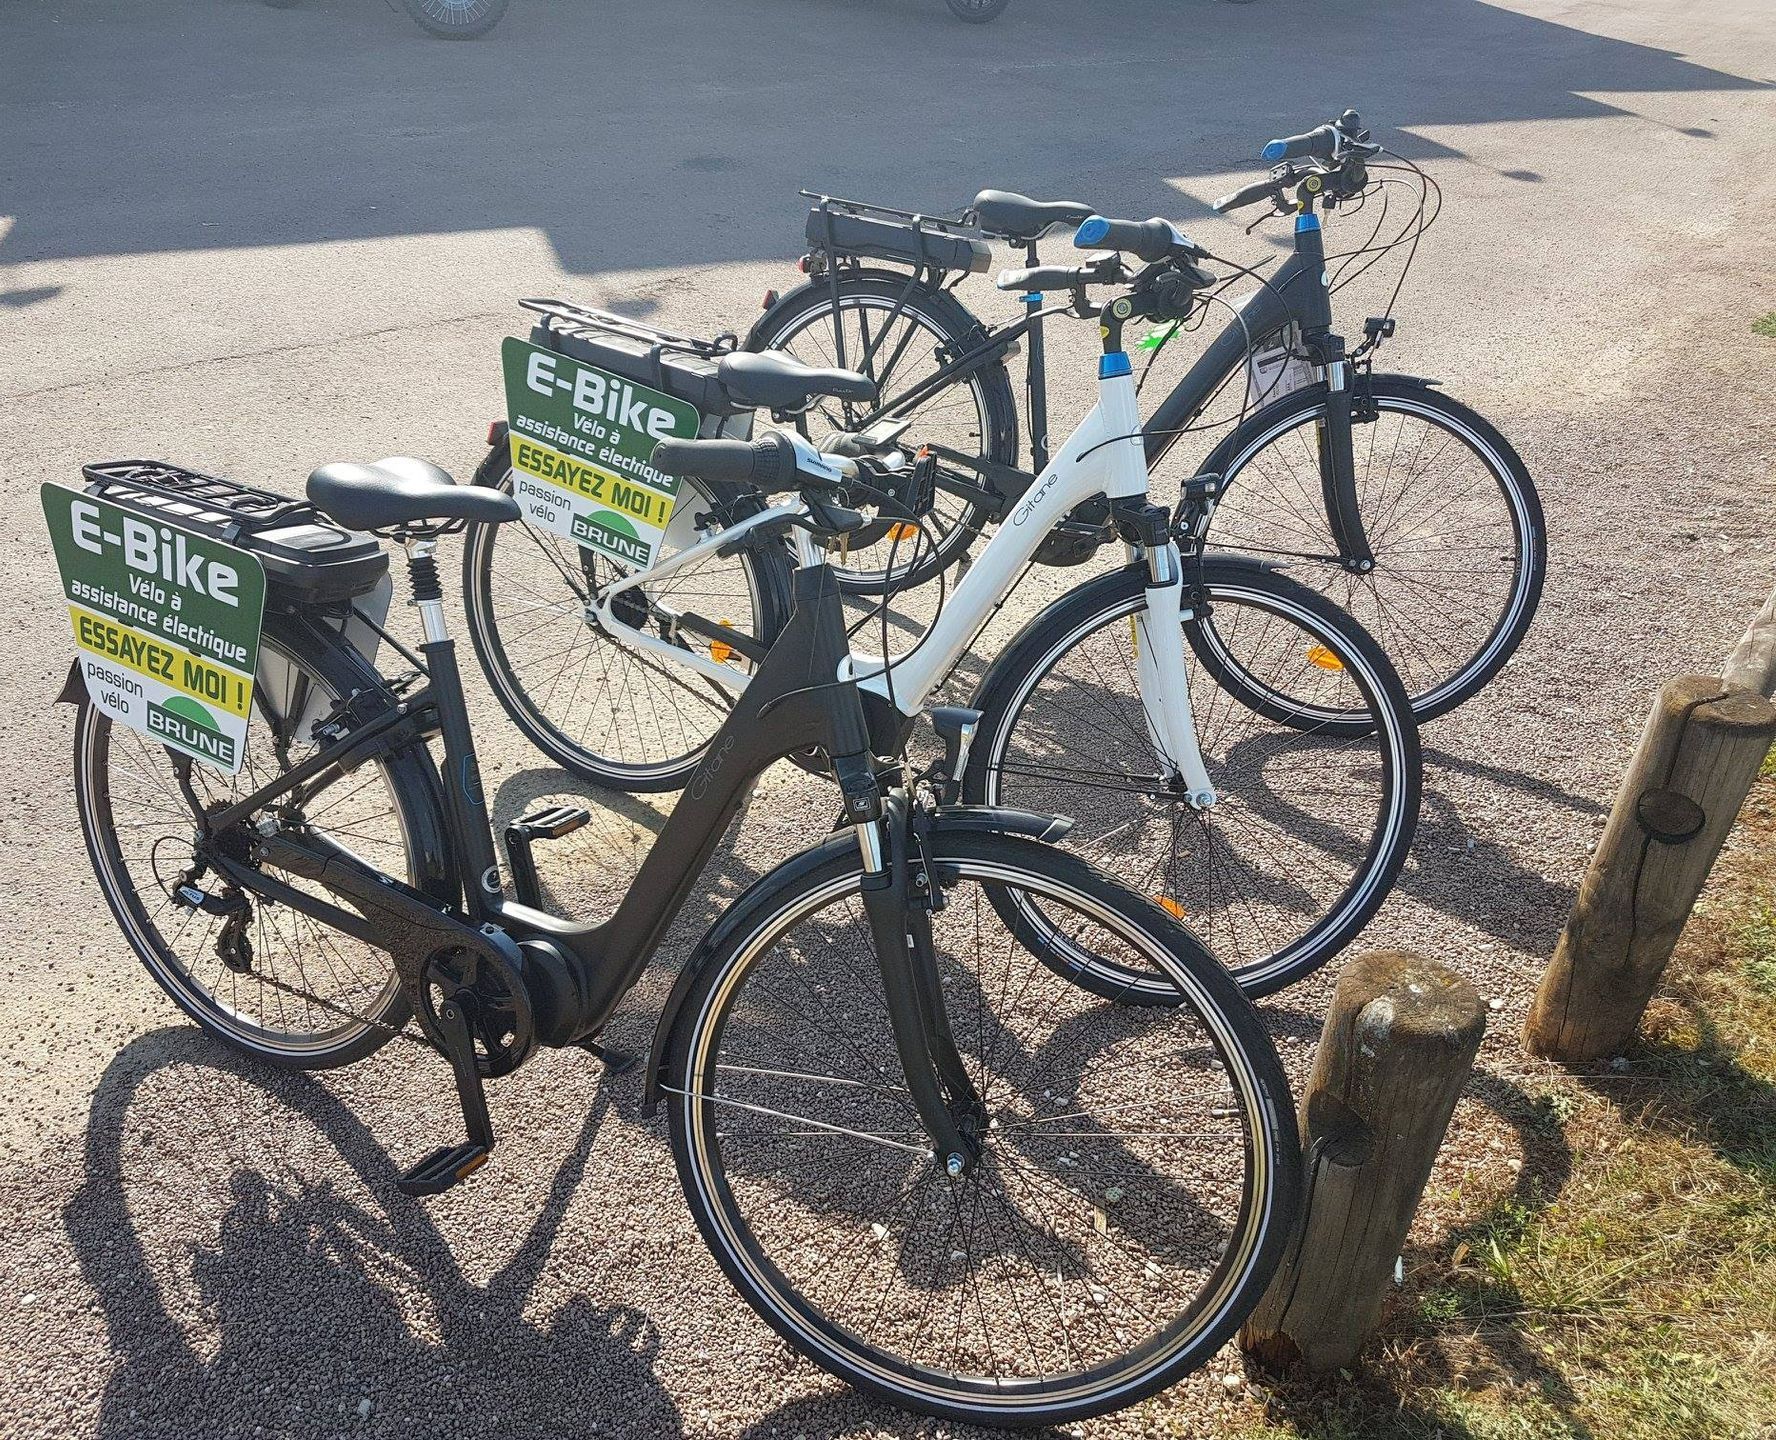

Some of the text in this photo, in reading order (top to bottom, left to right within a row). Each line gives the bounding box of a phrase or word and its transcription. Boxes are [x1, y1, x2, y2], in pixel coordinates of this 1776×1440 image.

[527, 351, 676, 440] E-Bike
[517, 414, 673, 488] assistance électrique
[573, 412, 621, 445] Vélo à
[517, 444, 666, 523] ESSAYEZ MOI !
[519, 479, 571, 511] passion
[1013, 473, 1058, 527] Gitane
[529, 502, 556, 523] vélo
[70, 500, 239, 608] E-Bike
[573, 520, 649, 562] BRUNE
[128, 573, 182, 612] Vélo à
[71, 578, 247, 663] assistance électrique
[79, 616, 244, 710] ESSAYEZ MOI !
[87, 661, 143, 699] passion
[100, 689, 129, 715] vélo
[149, 712, 234, 764] BRUNE
[691, 735, 735, 800] Gitane
